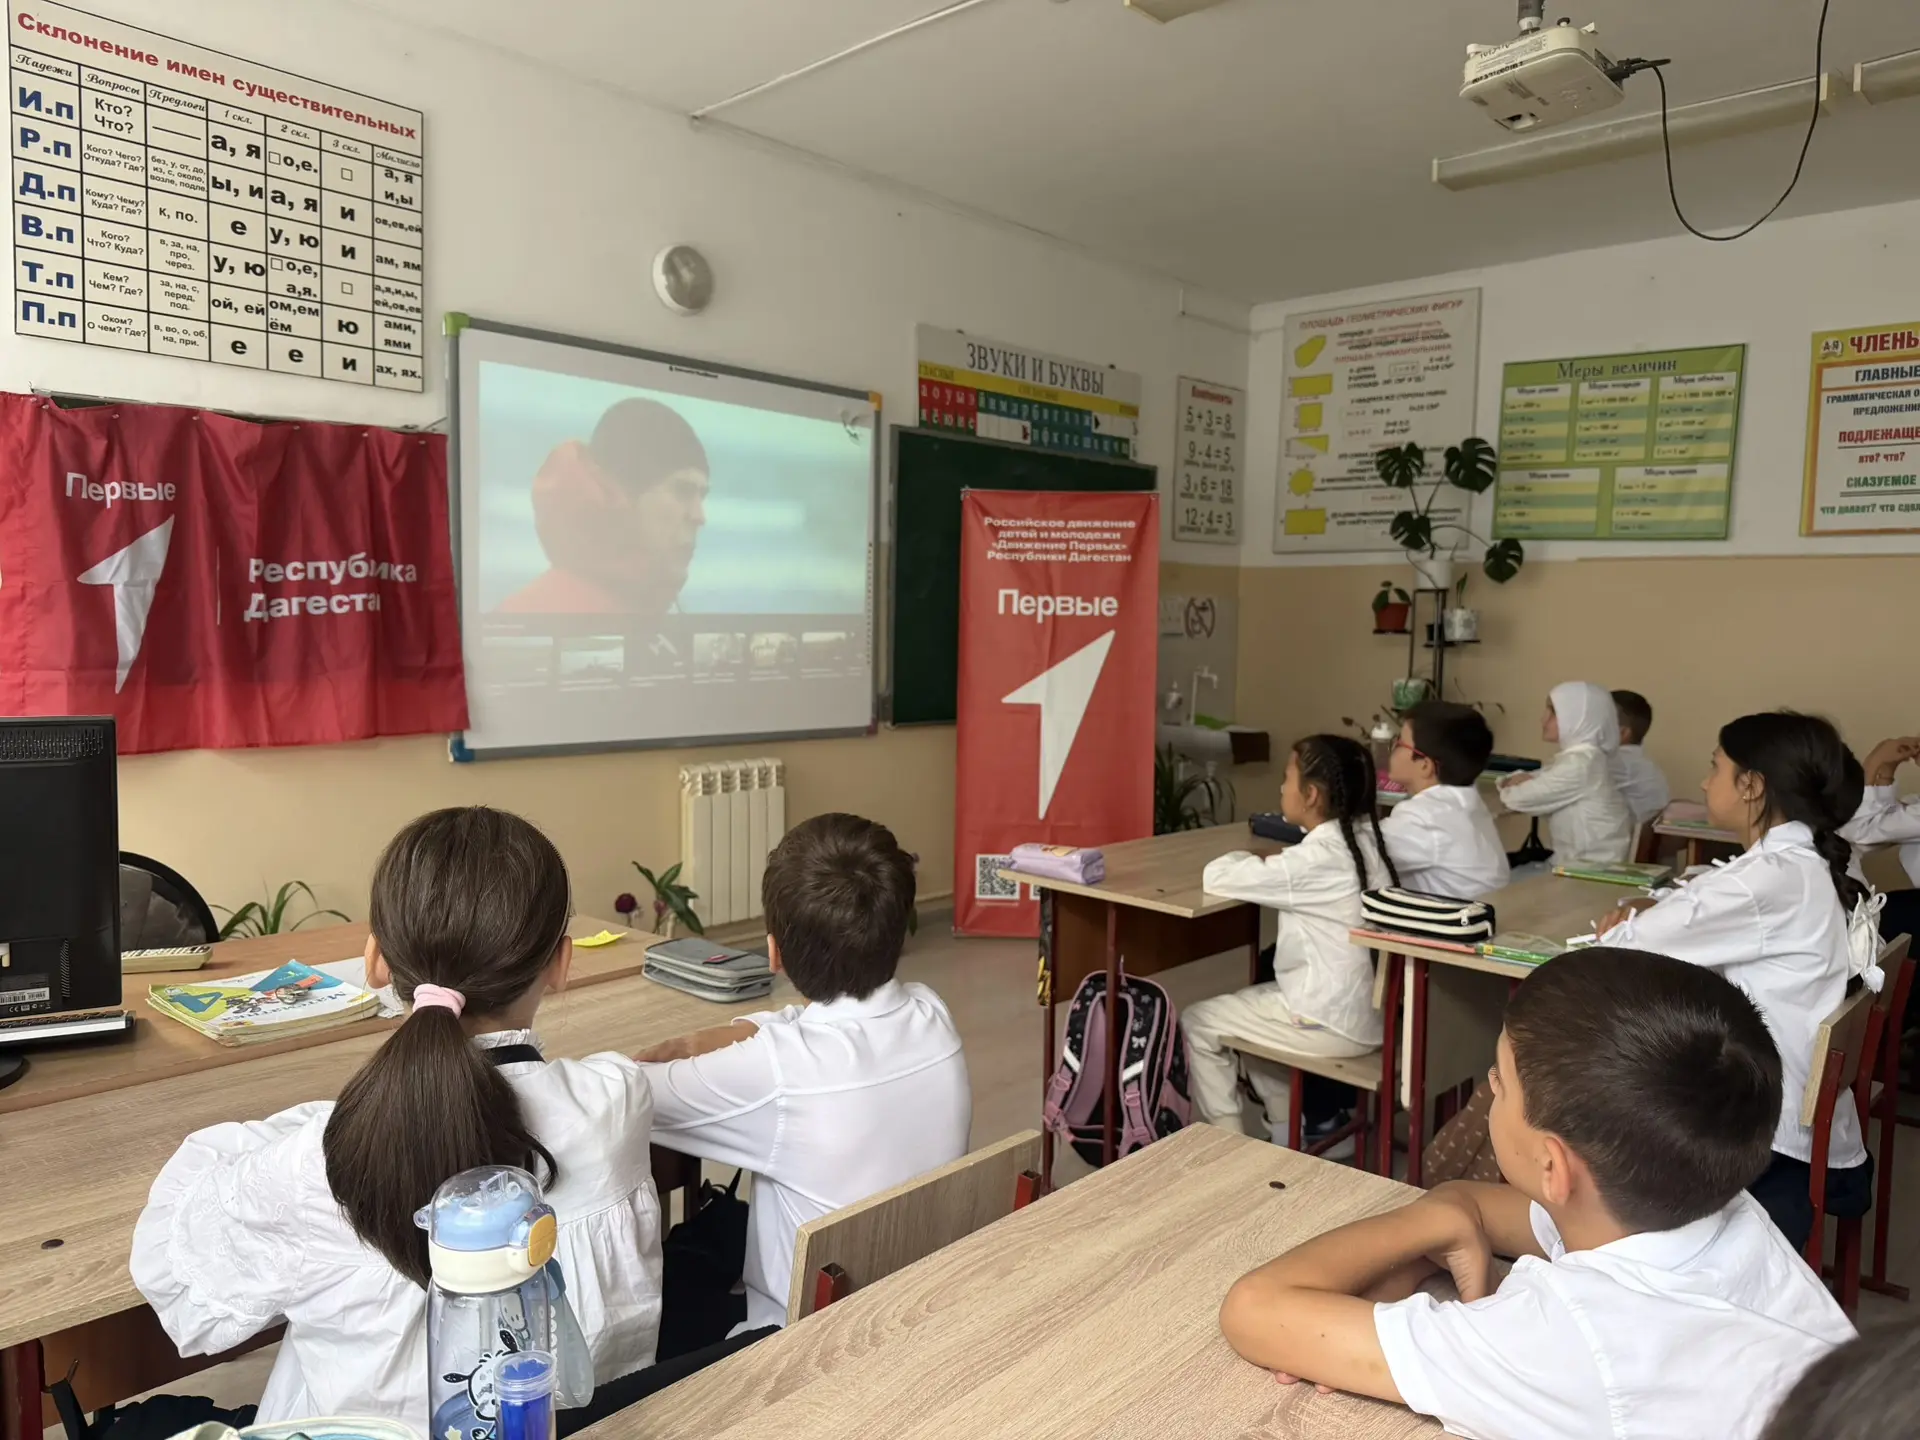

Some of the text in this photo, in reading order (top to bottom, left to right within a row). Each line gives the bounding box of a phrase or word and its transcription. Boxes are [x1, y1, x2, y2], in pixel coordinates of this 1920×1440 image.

[16, 54, 72, 77] Падежи
[17, 12, 416, 139] Склонение имен существительных
[85, 73, 140, 95] Вопросы
[19, 87, 73, 120] И.п
[95, 97, 132, 116] Кто?
[148, 89, 206, 111] Предлоги
[95, 114, 133, 134] Что?
[232, 113, 252, 124] скл.
[281, 124, 310, 139] 2 скл.
[20, 127, 71, 158] Р.п
[342, 144, 360, 154] скл.
[87, 144, 141, 162] Кого? Чего?
[246, 143, 261, 159] я
[84, 152, 145, 172] Откуда? Где?
[150, 174, 178, 185] возле,
[405, 174, 413, 184] я
[20, 172, 75, 202] Д.п
[249, 185, 263, 199] и
[85, 189, 145, 207] Кому? Чему?
[270, 189, 318, 212] а, я
[92, 199, 142, 216] Куда? Где?
[340, 206, 355, 221] и
[21, 214, 73, 243] В.п
[231, 220, 247, 235] е
[101, 230, 130, 242] Кого?
[299, 233, 319, 248] ю
[87, 238, 143, 255] Что? Куда?
[342, 245, 356, 259] и
[166, 259, 195, 271] через.
[245, 261, 265, 277] ю
[403, 260, 422, 271] ям
[22, 261, 73, 289] Т.п
[103, 272, 129, 282] Кем?
[89, 279, 143, 296] Чем? Где?
[212, 297, 265, 315] ой, ей
[22, 301, 75, 328] П.п
[98, 325, 121, 334] чем?
[125, 327, 146, 337] Где?
[270, 318, 292, 333] ём
[338, 320, 359, 335] ю
[231, 340, 247, 354] е
[384, 338, 411, 350] ями
[289, 349, 304, 363] е
[343, 357, 357, 371] и
[967, 342, 1025, 379] ЗВУКИ
[1033, 356, 1043, 383] И
[1049, 361, 1103, 395] БУКВЫ
[1557, 360, 1676, 381] Меры величин
[1855, 365, 1920, 382] ГЛАВНЫЕ
[1826, 390, 1911, 404] ГРАММАТИЧЕСКАЯ
[1846, 474, 1917, 488] СКАЗУЕМОЕ
[65, 472, 176, 509] Первые
[984, 517, 1136, 529] Российское движение
[998, 530, 1037, 539] детей
[1051, 531, 1121, 541] молодежи
[992, 541, 1126, 551] «Движение Первых»
[987, 551, 1131, 563] Республики Дагестан
[998, 588, 1118, 624] Первые
